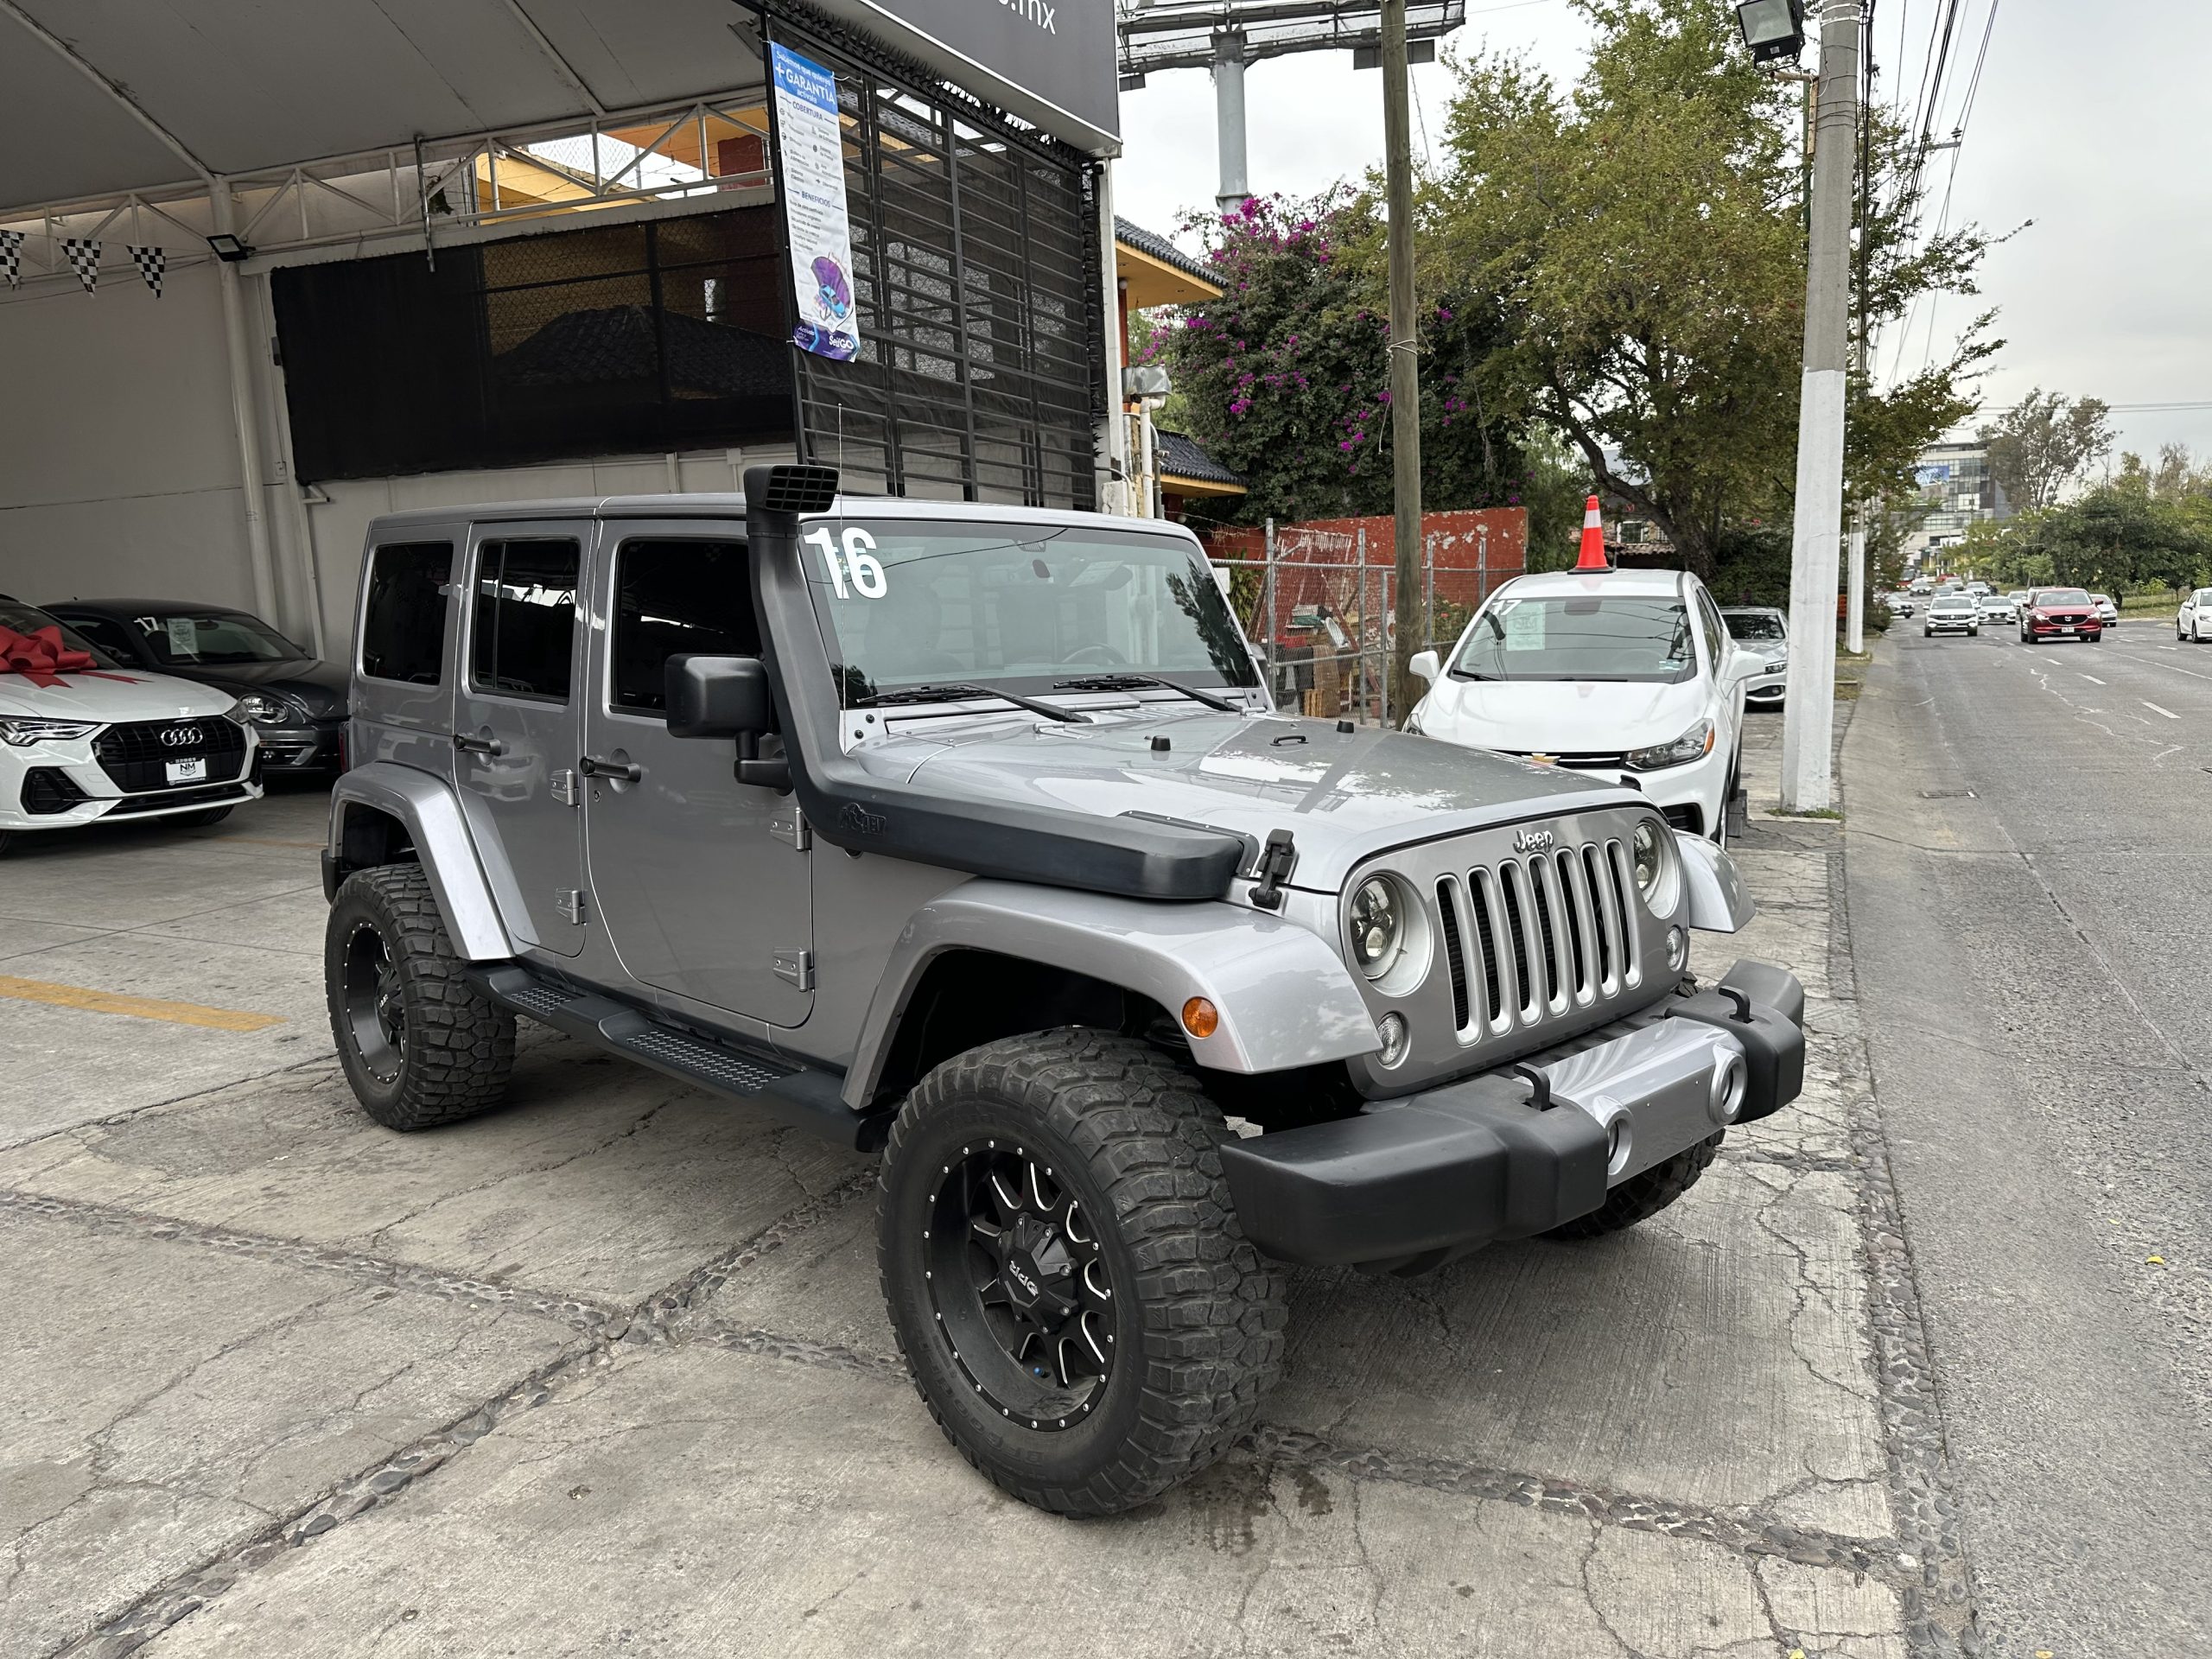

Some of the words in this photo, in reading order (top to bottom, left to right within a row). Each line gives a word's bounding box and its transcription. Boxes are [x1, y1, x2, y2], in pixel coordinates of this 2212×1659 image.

[998, 0, 1056, 35] .mx
[792, 101, 823, 121] COBERTURA
[801, 190, 831, 207] BENEFICIOS
[804, 527, 887, 600] 16
[1492, 599, 1522, 616] 17
[134, 616, 159, 632] 17
[1513, 830, 1554, 854] Jeep
